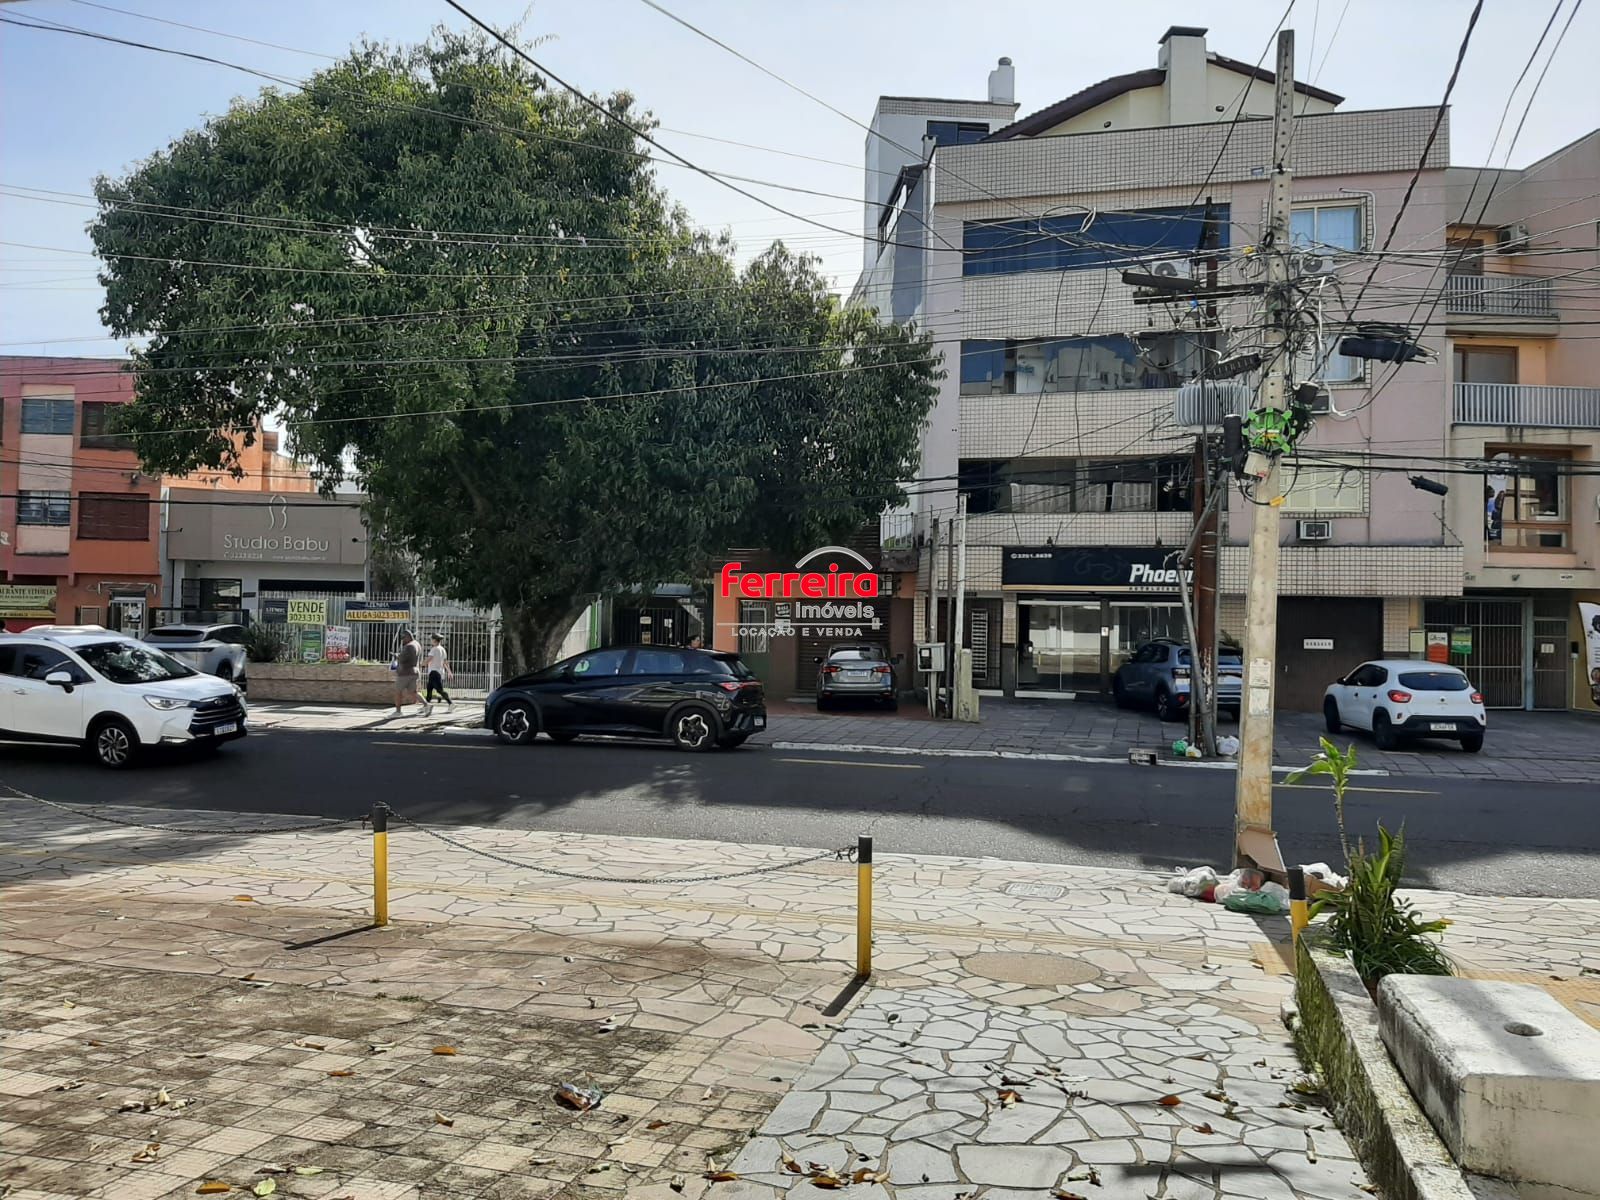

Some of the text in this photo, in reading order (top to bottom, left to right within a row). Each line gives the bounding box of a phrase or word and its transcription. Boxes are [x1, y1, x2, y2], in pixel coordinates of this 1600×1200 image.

[223, 534, 329, 551] Studio Babu
[290, 601, 325, 613] VENDE
